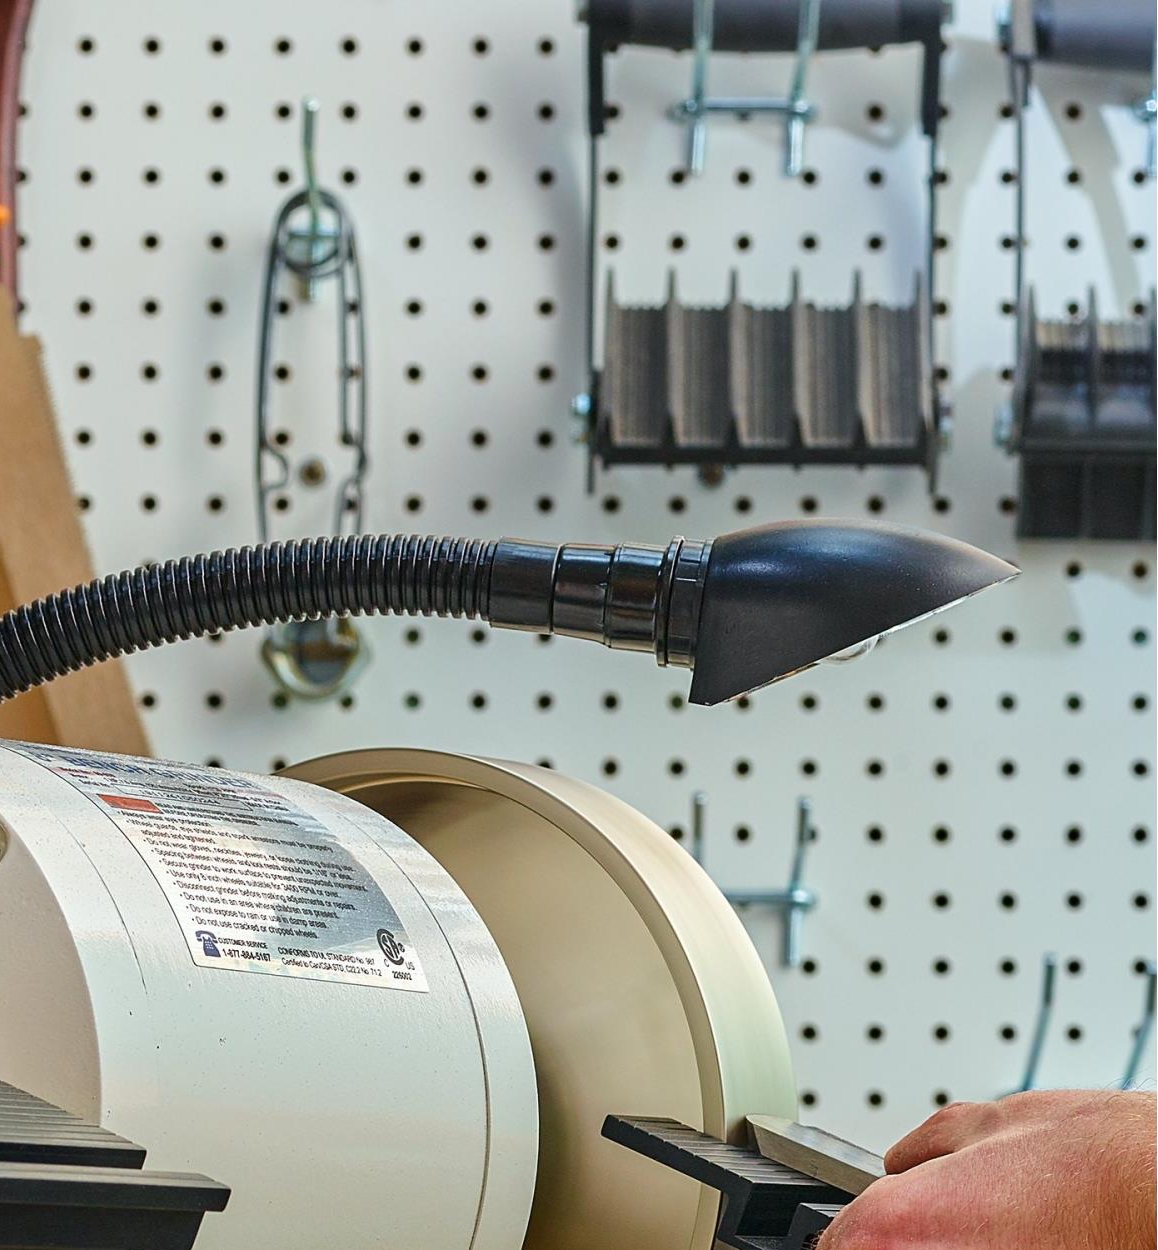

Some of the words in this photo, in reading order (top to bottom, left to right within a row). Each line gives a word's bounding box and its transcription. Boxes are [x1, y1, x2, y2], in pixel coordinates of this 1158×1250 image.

[176, 880, 215, 892] Disconnect
[215, 887, 238, 895] grinder
[239, 889, 261, 898] before
[261, 893, 287, 903] making
[183, 892, 195, 901] Do
[238, 900, 254, 908] area
[254, 902, 276, 911] where
[275, 904, 301, 914] children
[189, 903, 201, 913] Do
[214, 909, 238, 917] expose
[269, 915, 282, 923] use
[289, 917, 308, 927] damp
[195, 916, 207, 925] Do
[207, 919, 220, 927] not
[233, 922, 260, 932] cracked
[268, 927, 294, 936] chipped
